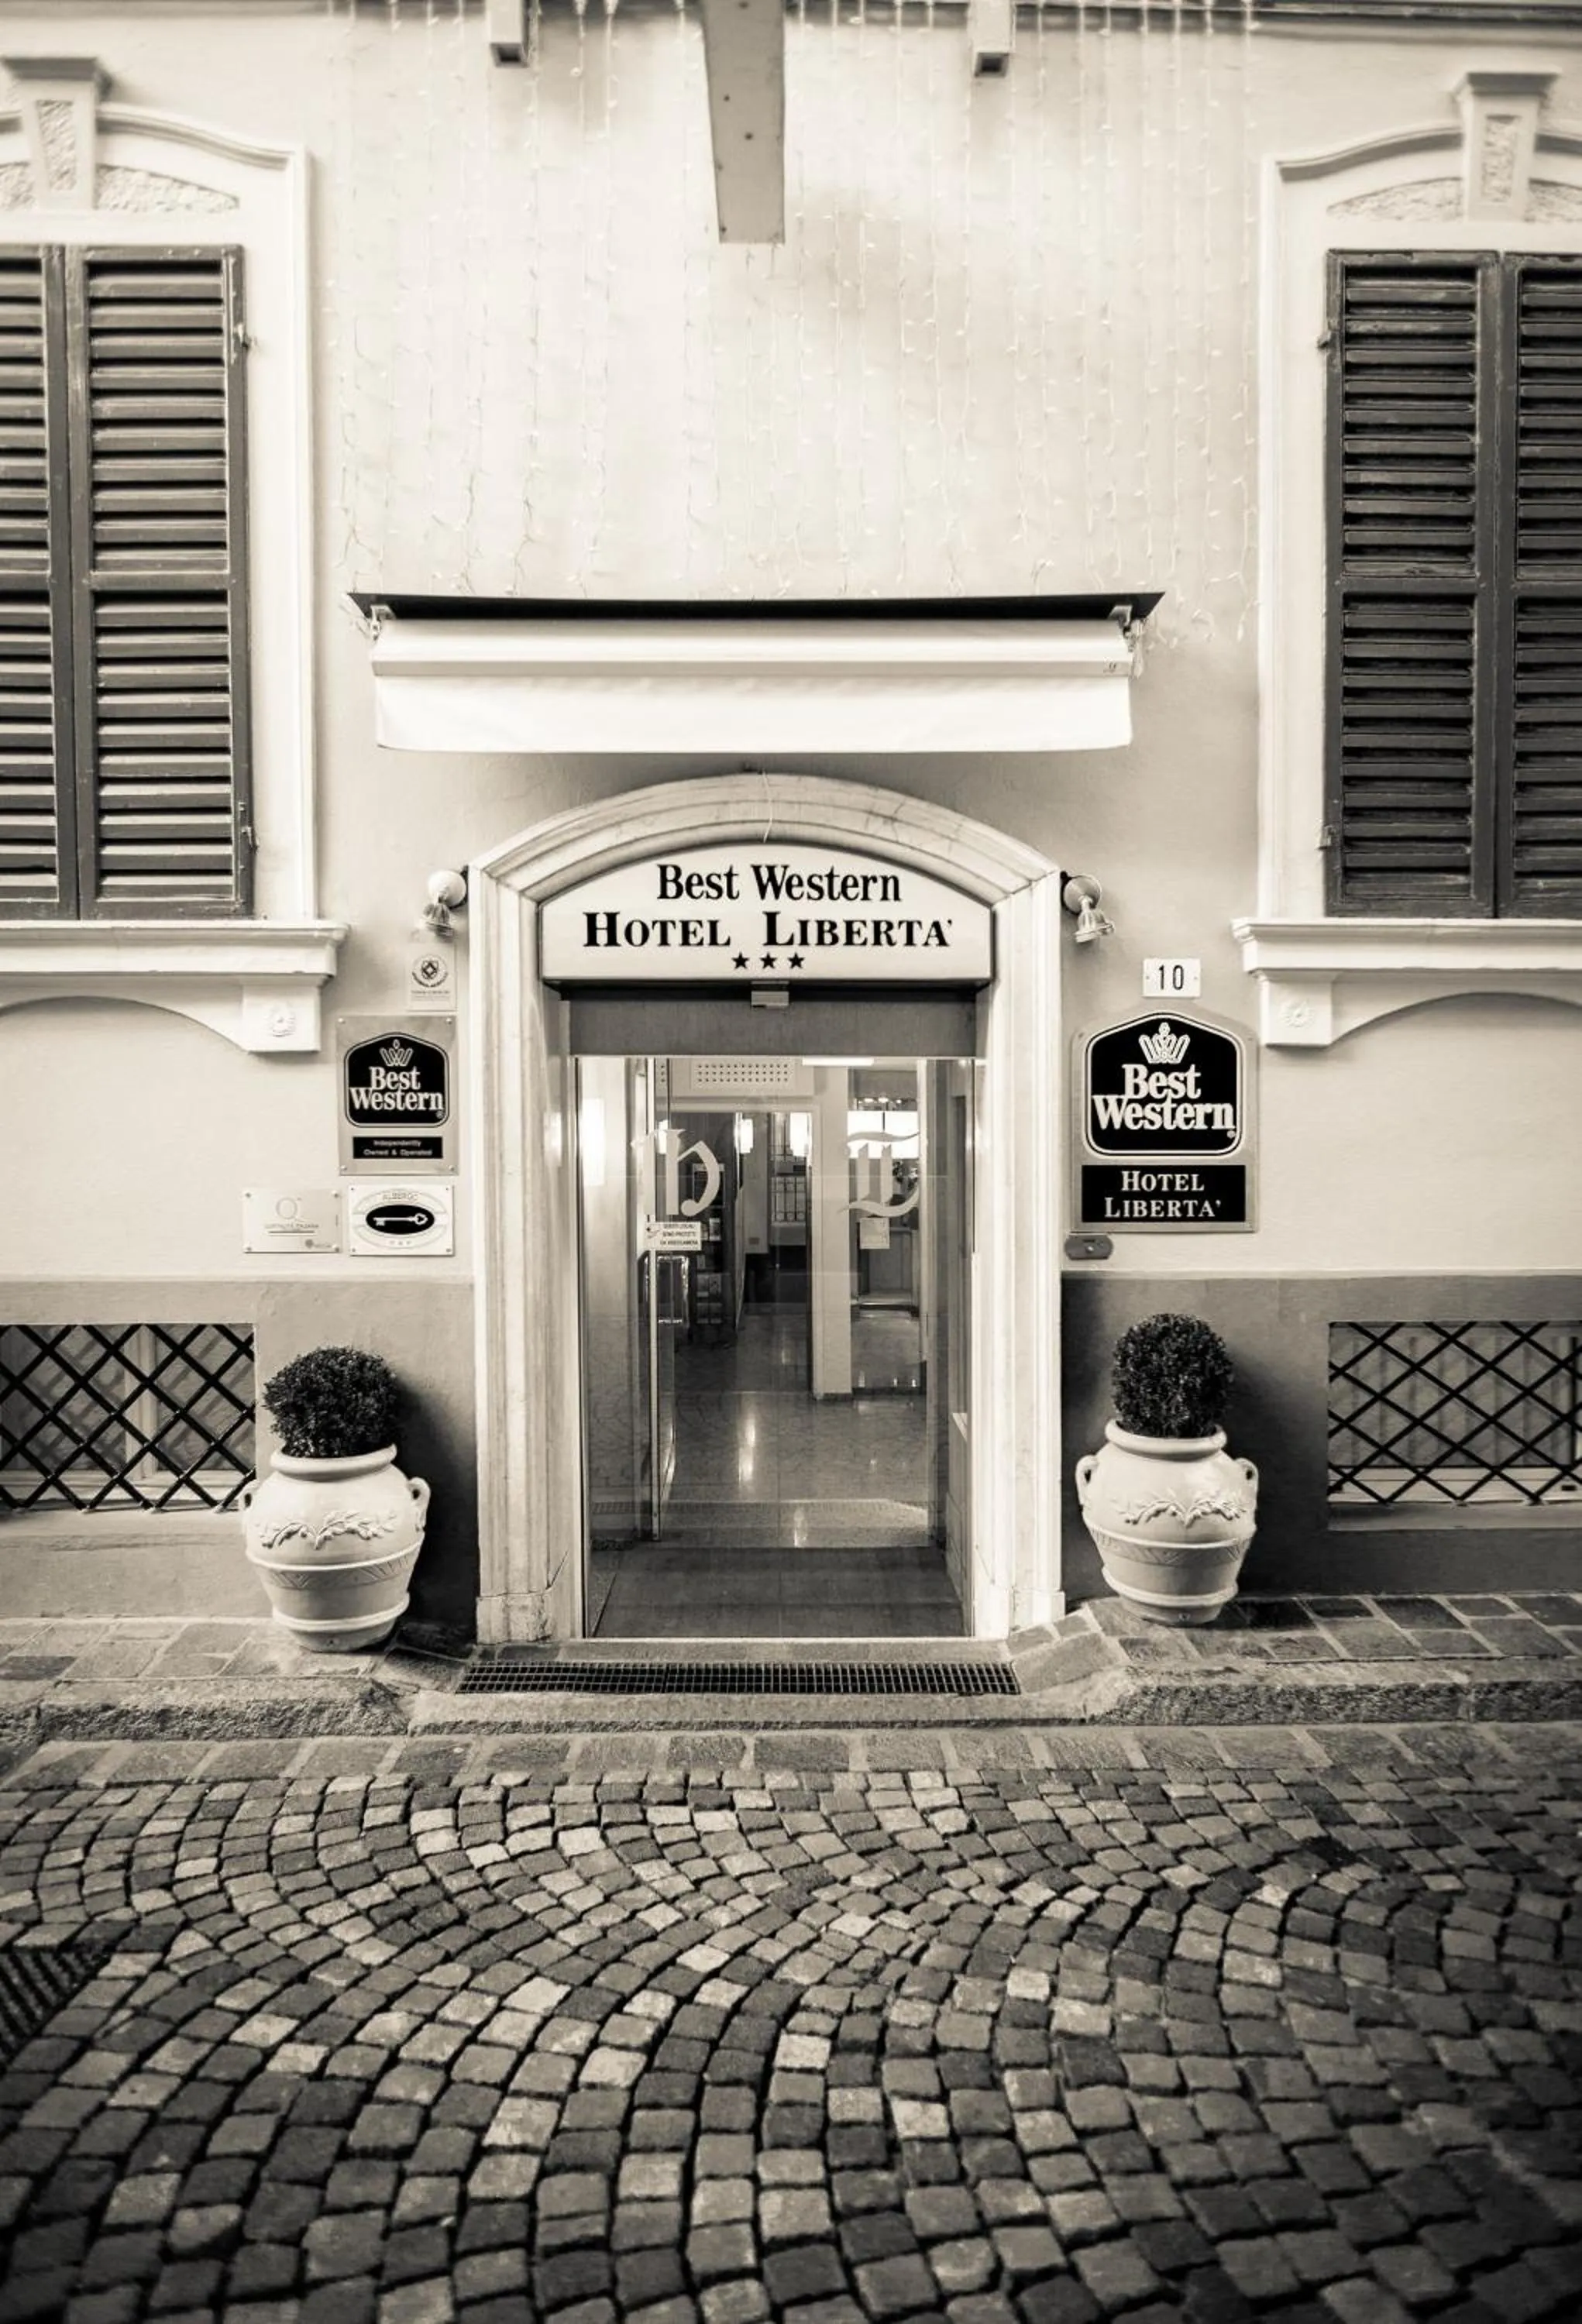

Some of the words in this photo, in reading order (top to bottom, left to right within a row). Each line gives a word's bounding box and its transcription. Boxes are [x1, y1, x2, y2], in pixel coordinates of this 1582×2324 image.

[656, 863, 740, 900] Best
[750, 863, 902, 901] Western
[582, 912, 731, 947] HOTEL
[1158, 964, 1185, 991] 10
[369, 1066, 421, 1091] Best
[1123, 1064, 1202, 1099] Best
[349, 1087, 444, 1111] Western
[1093, 1094, 1236, 1130] Western
[1121, 1171, 1205, 1191] HOTEL
